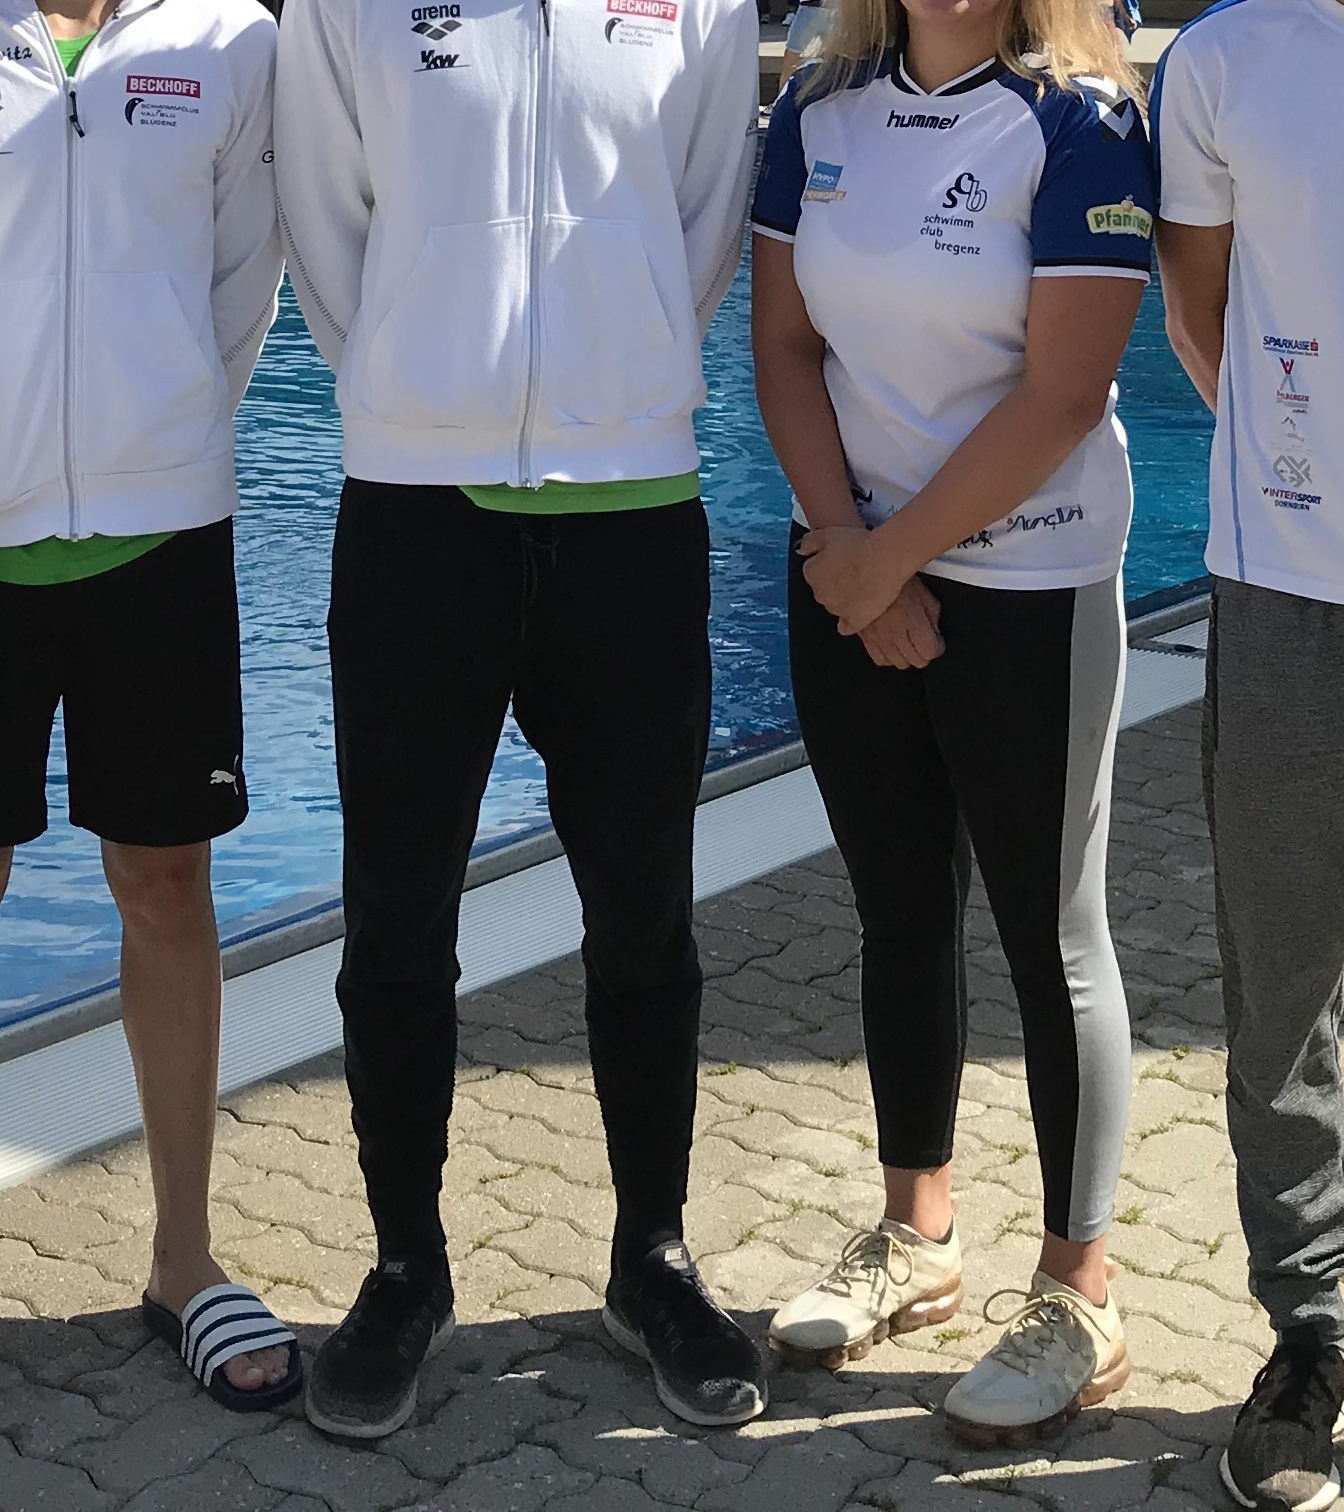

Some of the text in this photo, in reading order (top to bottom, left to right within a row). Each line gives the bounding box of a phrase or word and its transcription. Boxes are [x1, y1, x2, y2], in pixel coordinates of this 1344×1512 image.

[411, 4, 461, 21] arena
[130, 78, 198, 95] BECKHOFF
[887, 110, 960, 129] hummel
[812, 172, 835, 184] HYPO
[923, 214, 974, 228] schwimm
[920, 226, 943, 237] club
[934, 239, 981, 256] bregenz
[1263, 335, 1310, 351] SPARKASSE
